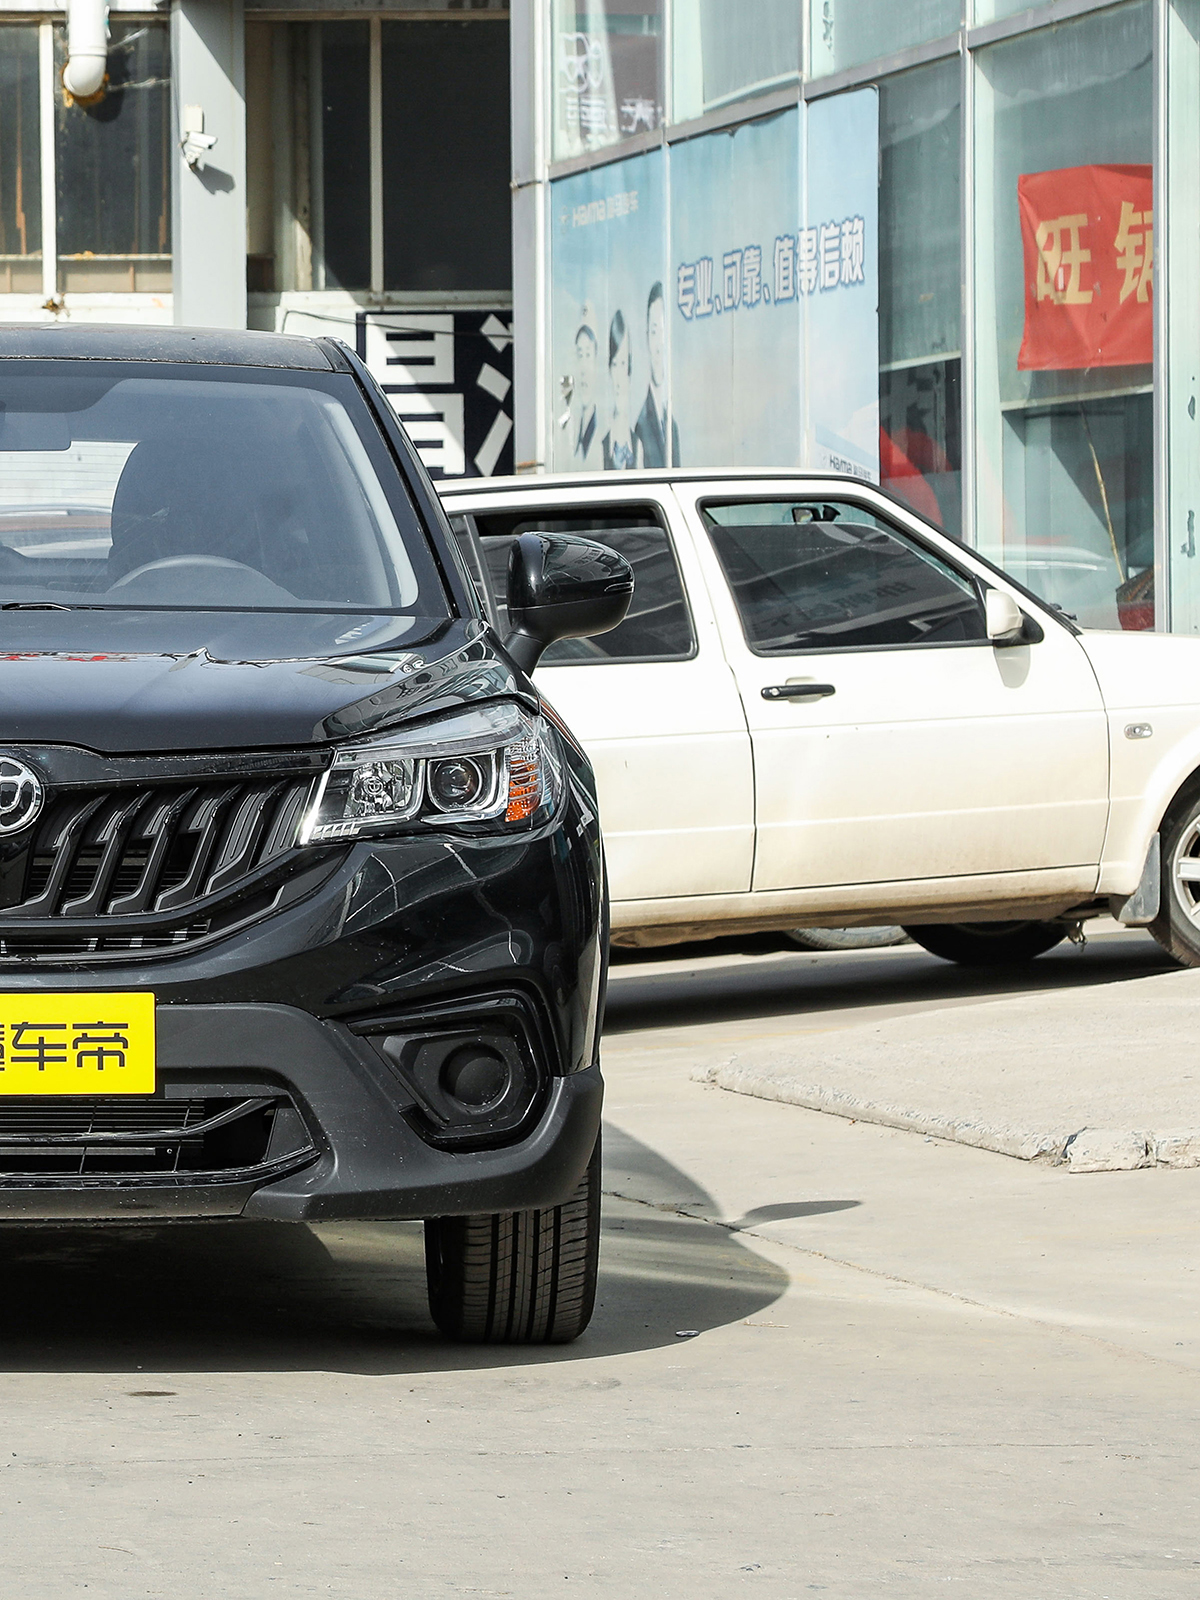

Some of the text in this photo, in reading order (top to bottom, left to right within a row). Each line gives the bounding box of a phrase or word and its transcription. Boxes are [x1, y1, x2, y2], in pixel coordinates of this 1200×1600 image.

[678, 214, 865, 320] 专业、可靠、值得信赖
